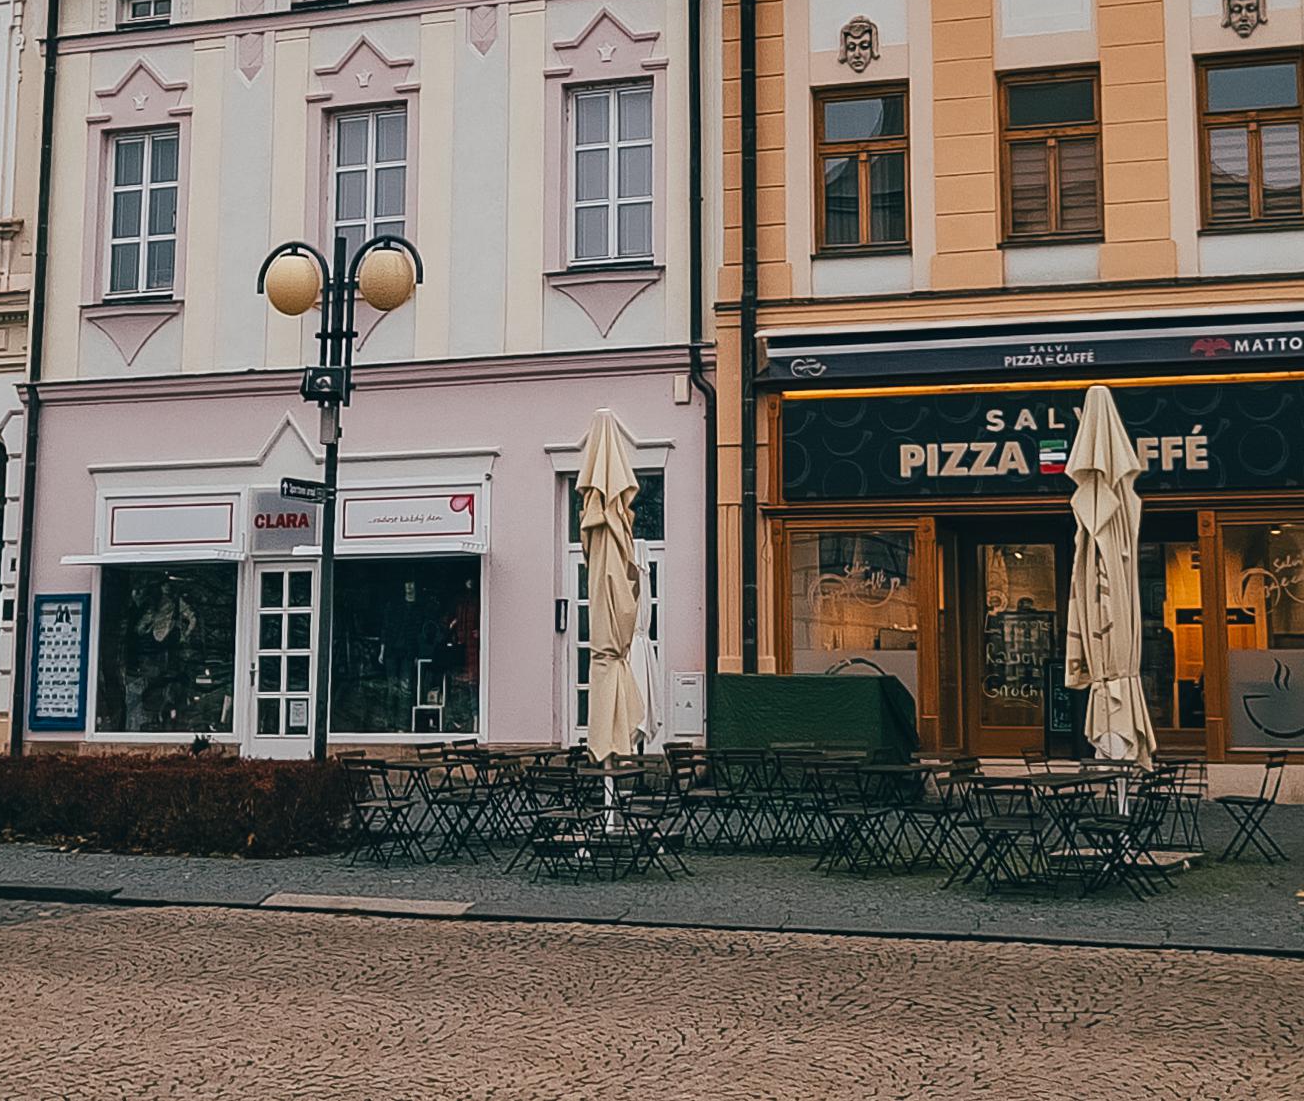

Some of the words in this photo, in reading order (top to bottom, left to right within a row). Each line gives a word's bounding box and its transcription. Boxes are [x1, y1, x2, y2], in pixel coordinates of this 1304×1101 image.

[1004, 355, 1043, 367] PIZZA
[1056, 349, 1094, 364] CAFFÉ
[1029, 345, 1068, 353] SALVI
[985, 406, 1084, 432] SAL
[899, 441, 1030, 477] PIZZA
[1136, 424, 1209, 471] FFÉ
[254, 513, 310, 529] CLARA
